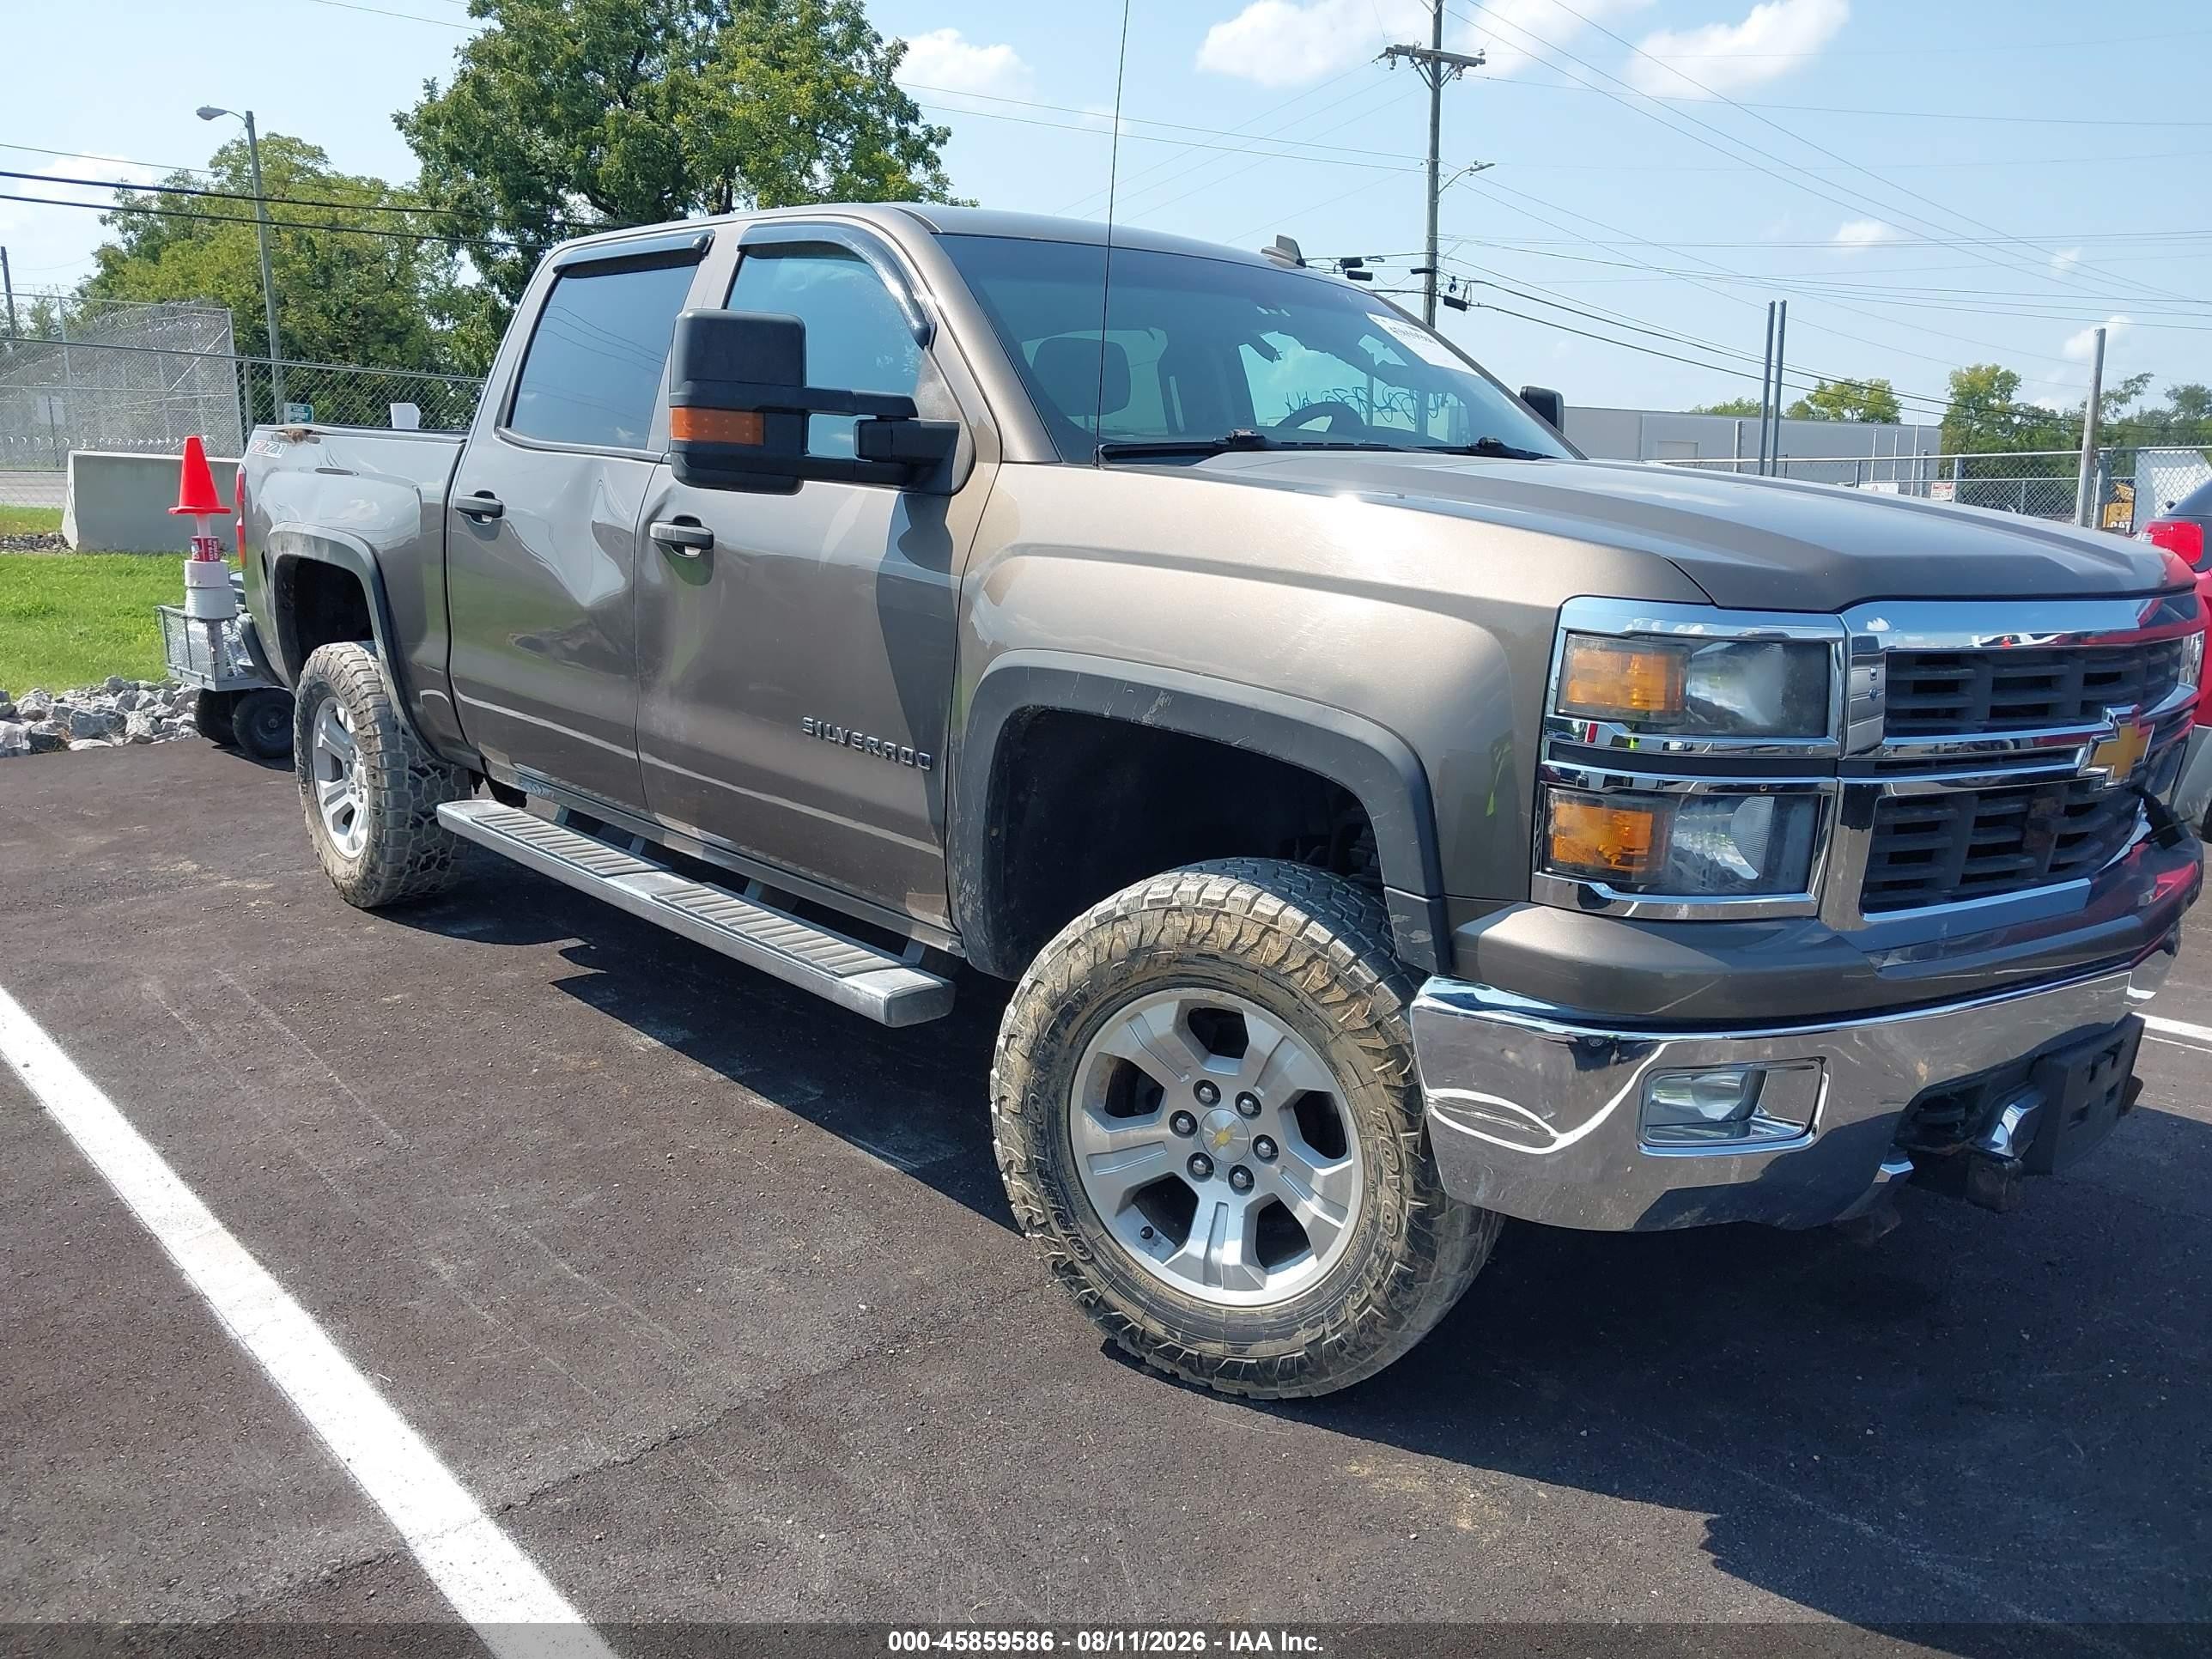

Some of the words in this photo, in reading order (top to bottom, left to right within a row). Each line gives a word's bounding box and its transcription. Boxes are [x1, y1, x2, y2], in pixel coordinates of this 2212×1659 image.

[249, 439, 288, 459] Z71
[801, 715, 933, 771] SILVERADO
[1369, 1106, 1406, 1237] TOYO
